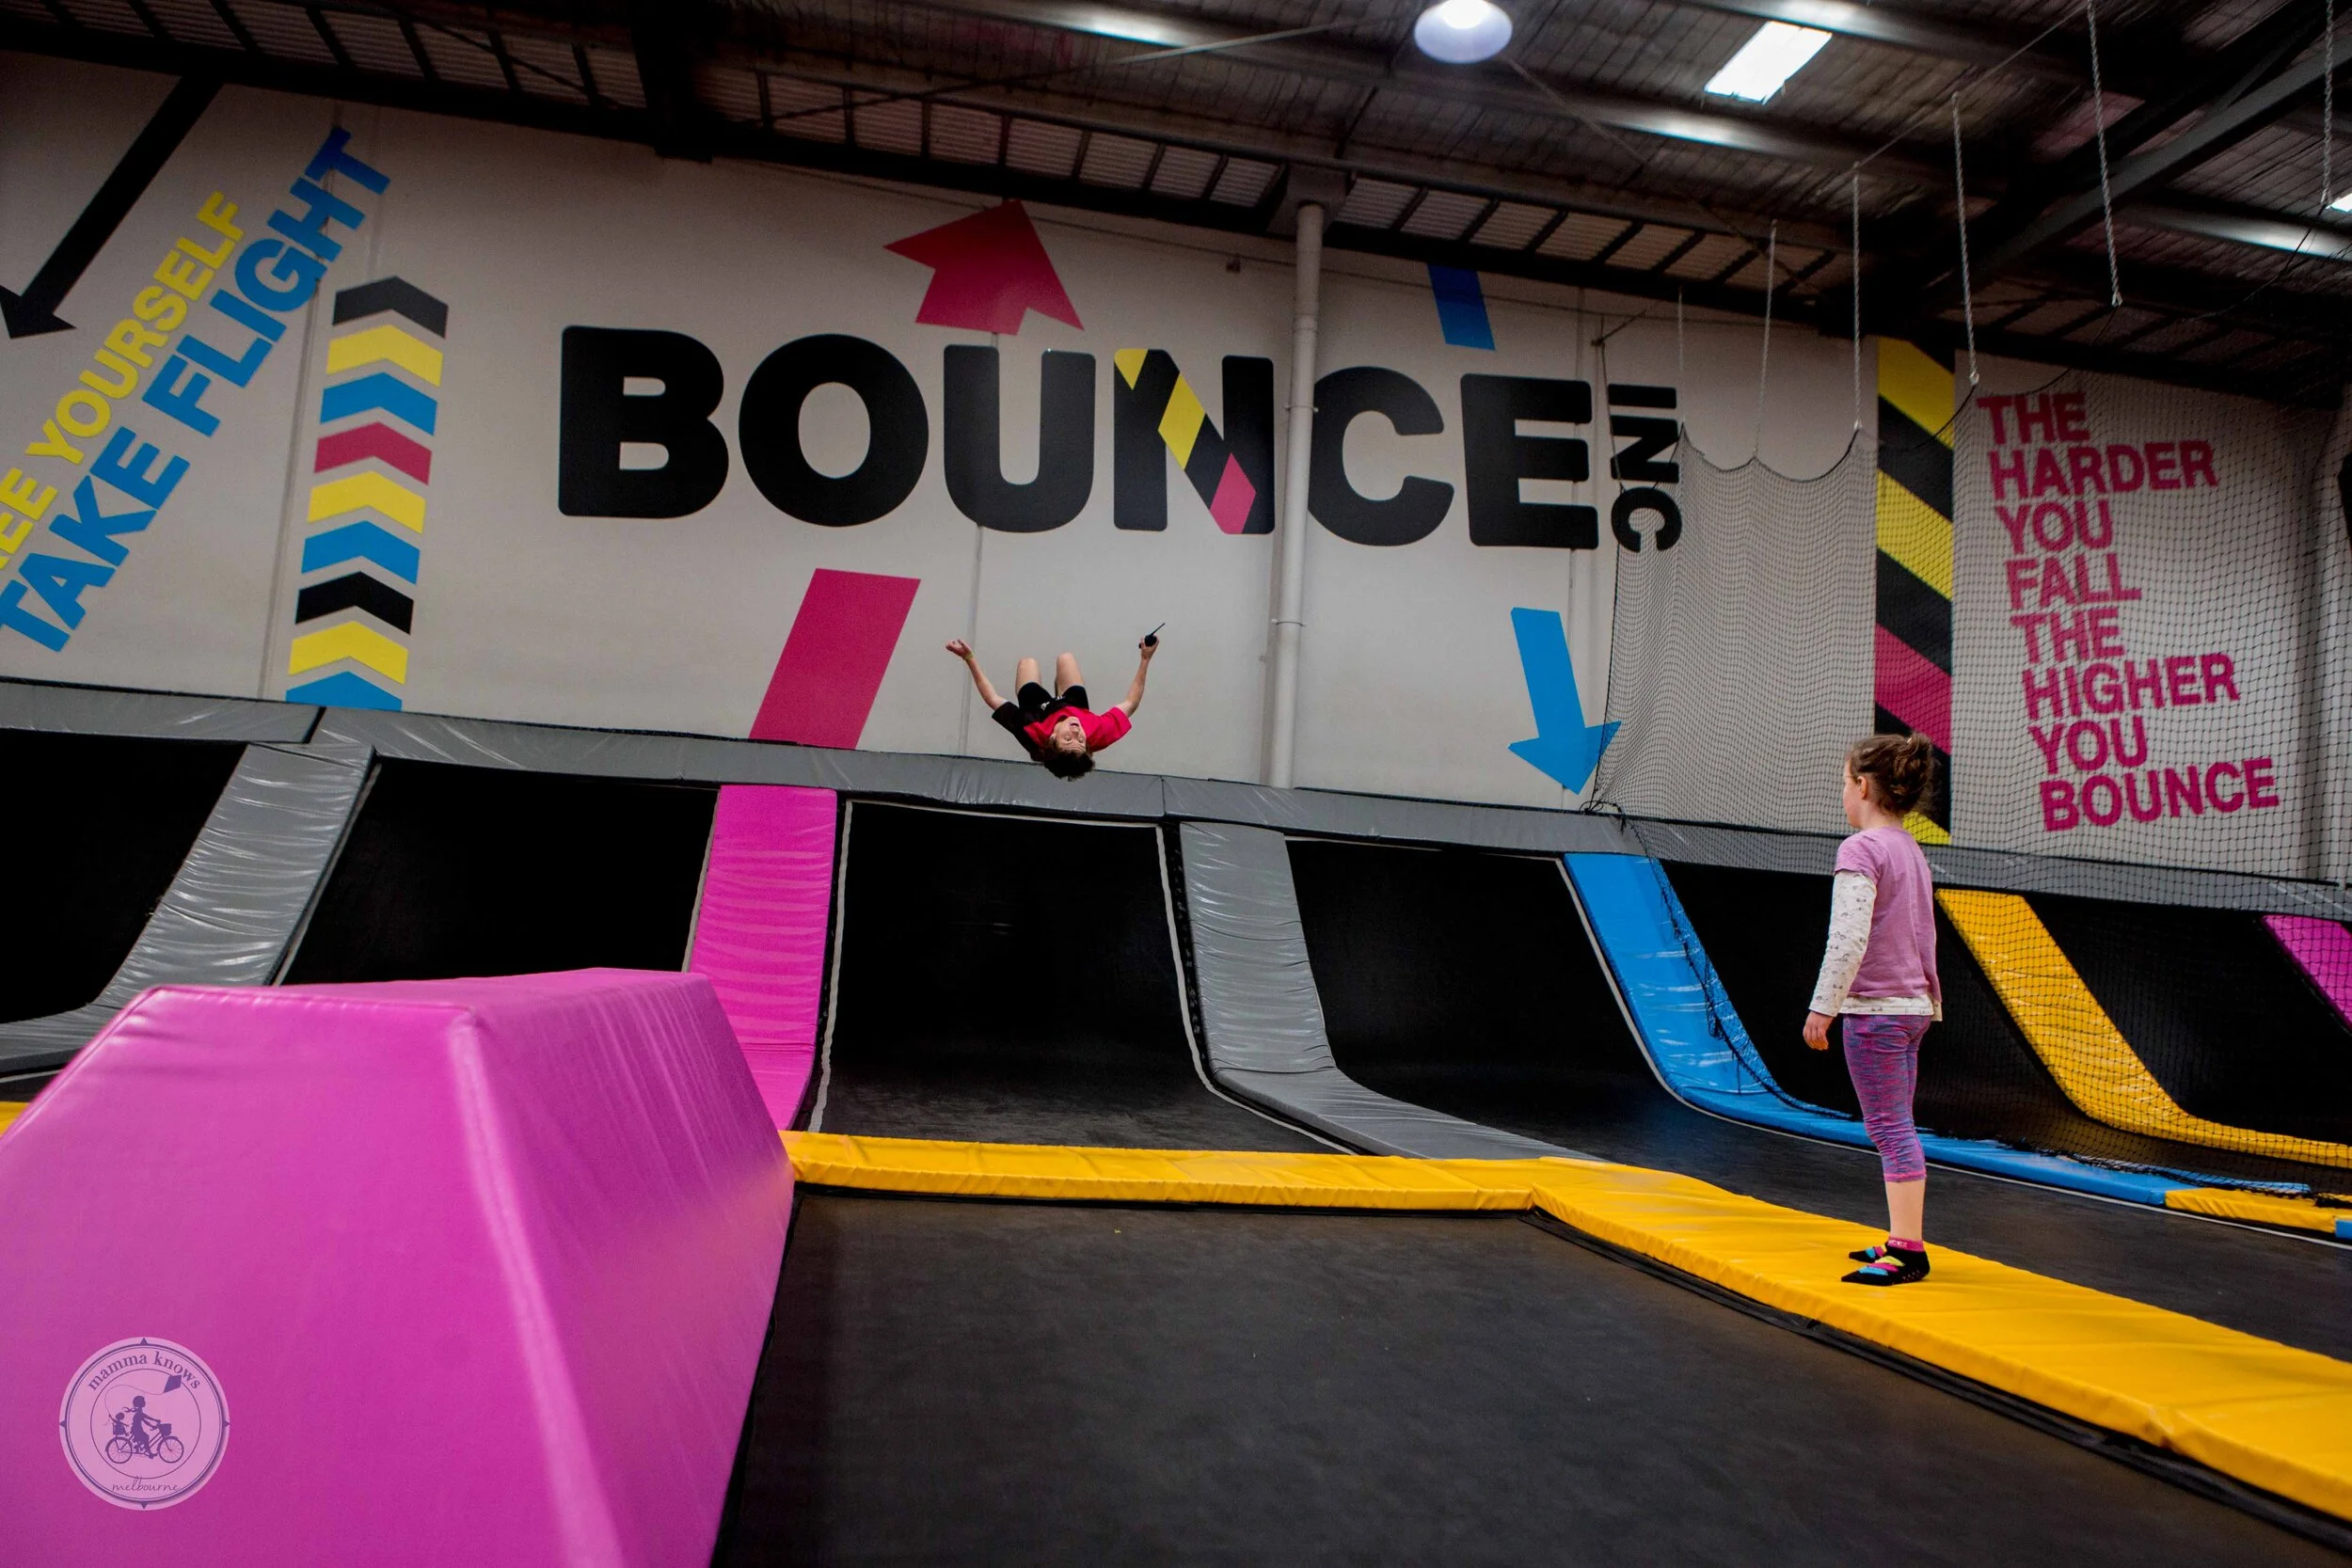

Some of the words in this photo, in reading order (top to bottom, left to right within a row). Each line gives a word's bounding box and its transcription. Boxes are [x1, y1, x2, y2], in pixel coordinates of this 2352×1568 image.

[25, 190, 245, 466] YOURSELF
[0, 426, 190, 653] TAKE
[141, 126, 391, 437] FLIGHT
[1977, 392, 2090, 446] THE
[558, 325, 1599, 551] BOUNCE
[1607, 383, 1683, 553] INC
[1987, 439, 2218, 500] HARDER
[1994, 499, 2114, 555] YOU
[2005, 553, 2142, 610] FALL
[2010, 608, 2125, 664] THE
[2022, 653, 2241, 721] HIGHER
[2027, 716, 2148, 775] YOU
[2039, 756, 2280, 832] BOUNCE
